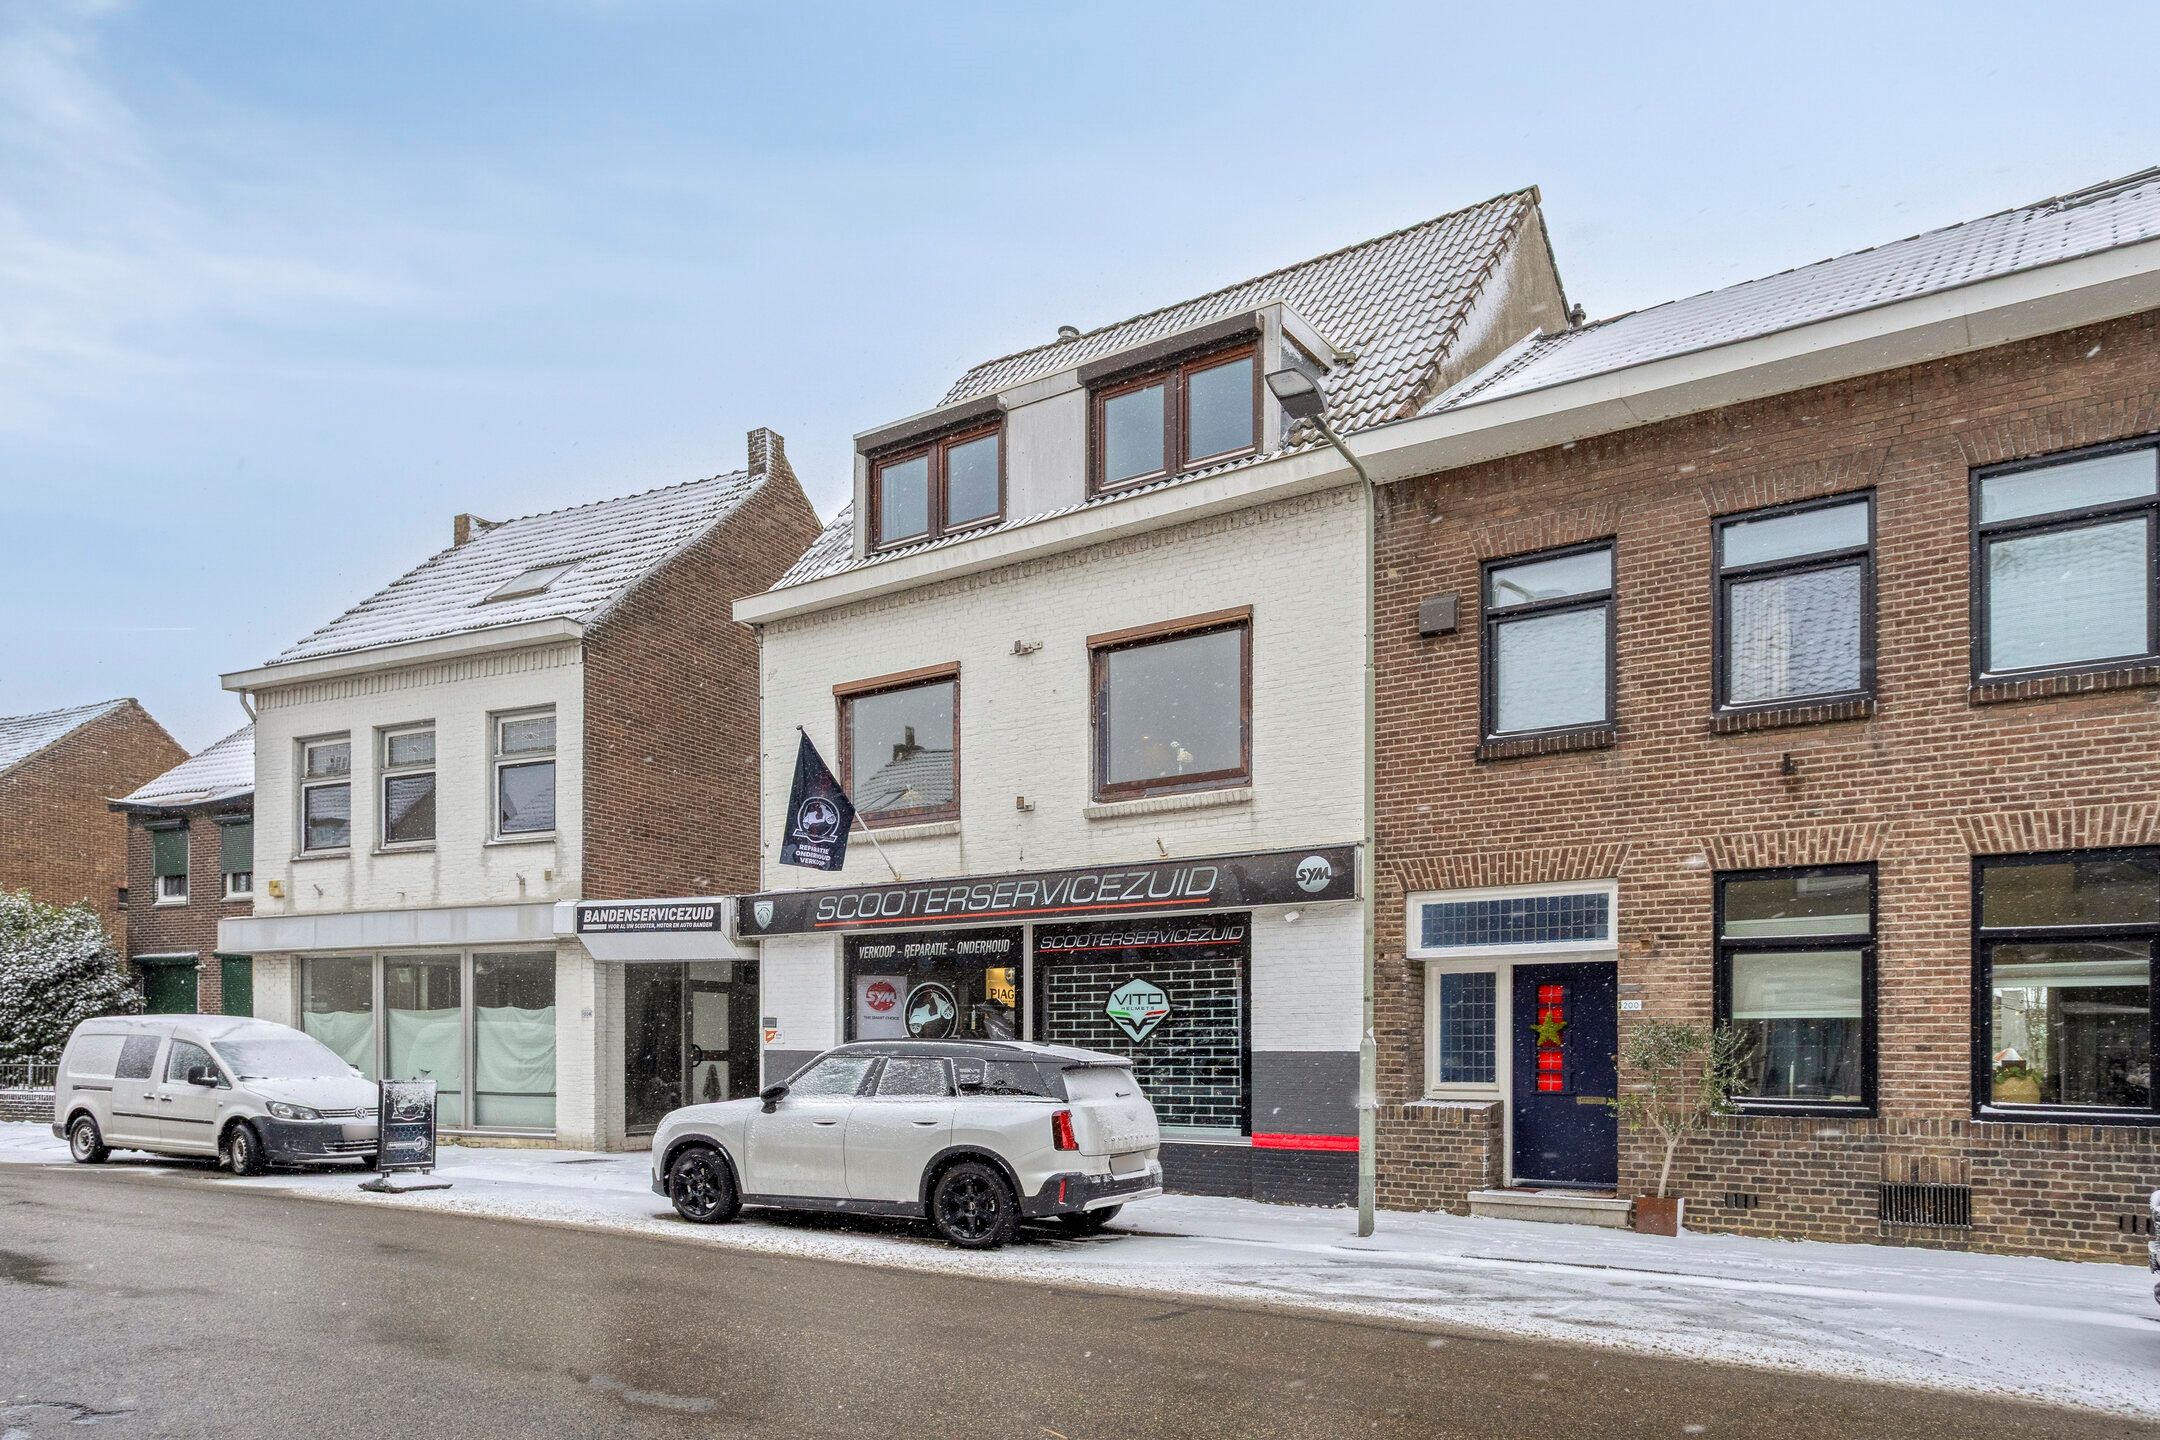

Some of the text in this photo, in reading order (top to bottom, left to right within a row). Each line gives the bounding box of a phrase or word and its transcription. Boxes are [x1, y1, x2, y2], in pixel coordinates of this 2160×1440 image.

[795, 850, 831, 860] ONDERHOUD
[799, 844, 830, 854] REPARATIE
[800, 857, 825, 866] VERKOOP
[1298, 867, 1331, 885] SYM
[816, 866, 1219, 921] SCOOTERSERVICEZUID
[583, 906, 715, 922] BANDENSERVICEZUID
[680, 921, 693, 929] AUTO
[1040, 926, 1244, 949] SCOOTERSERVICEZUID
[859, 945, 896, 959] VERKOOP
[904, 942, 949, 957] REPARATIE
[957, 939, 1010, 955] ONDERHOUD
[866, 991, 896, 1006] SYM
[1114, 993, 1162, 1005] VITO
